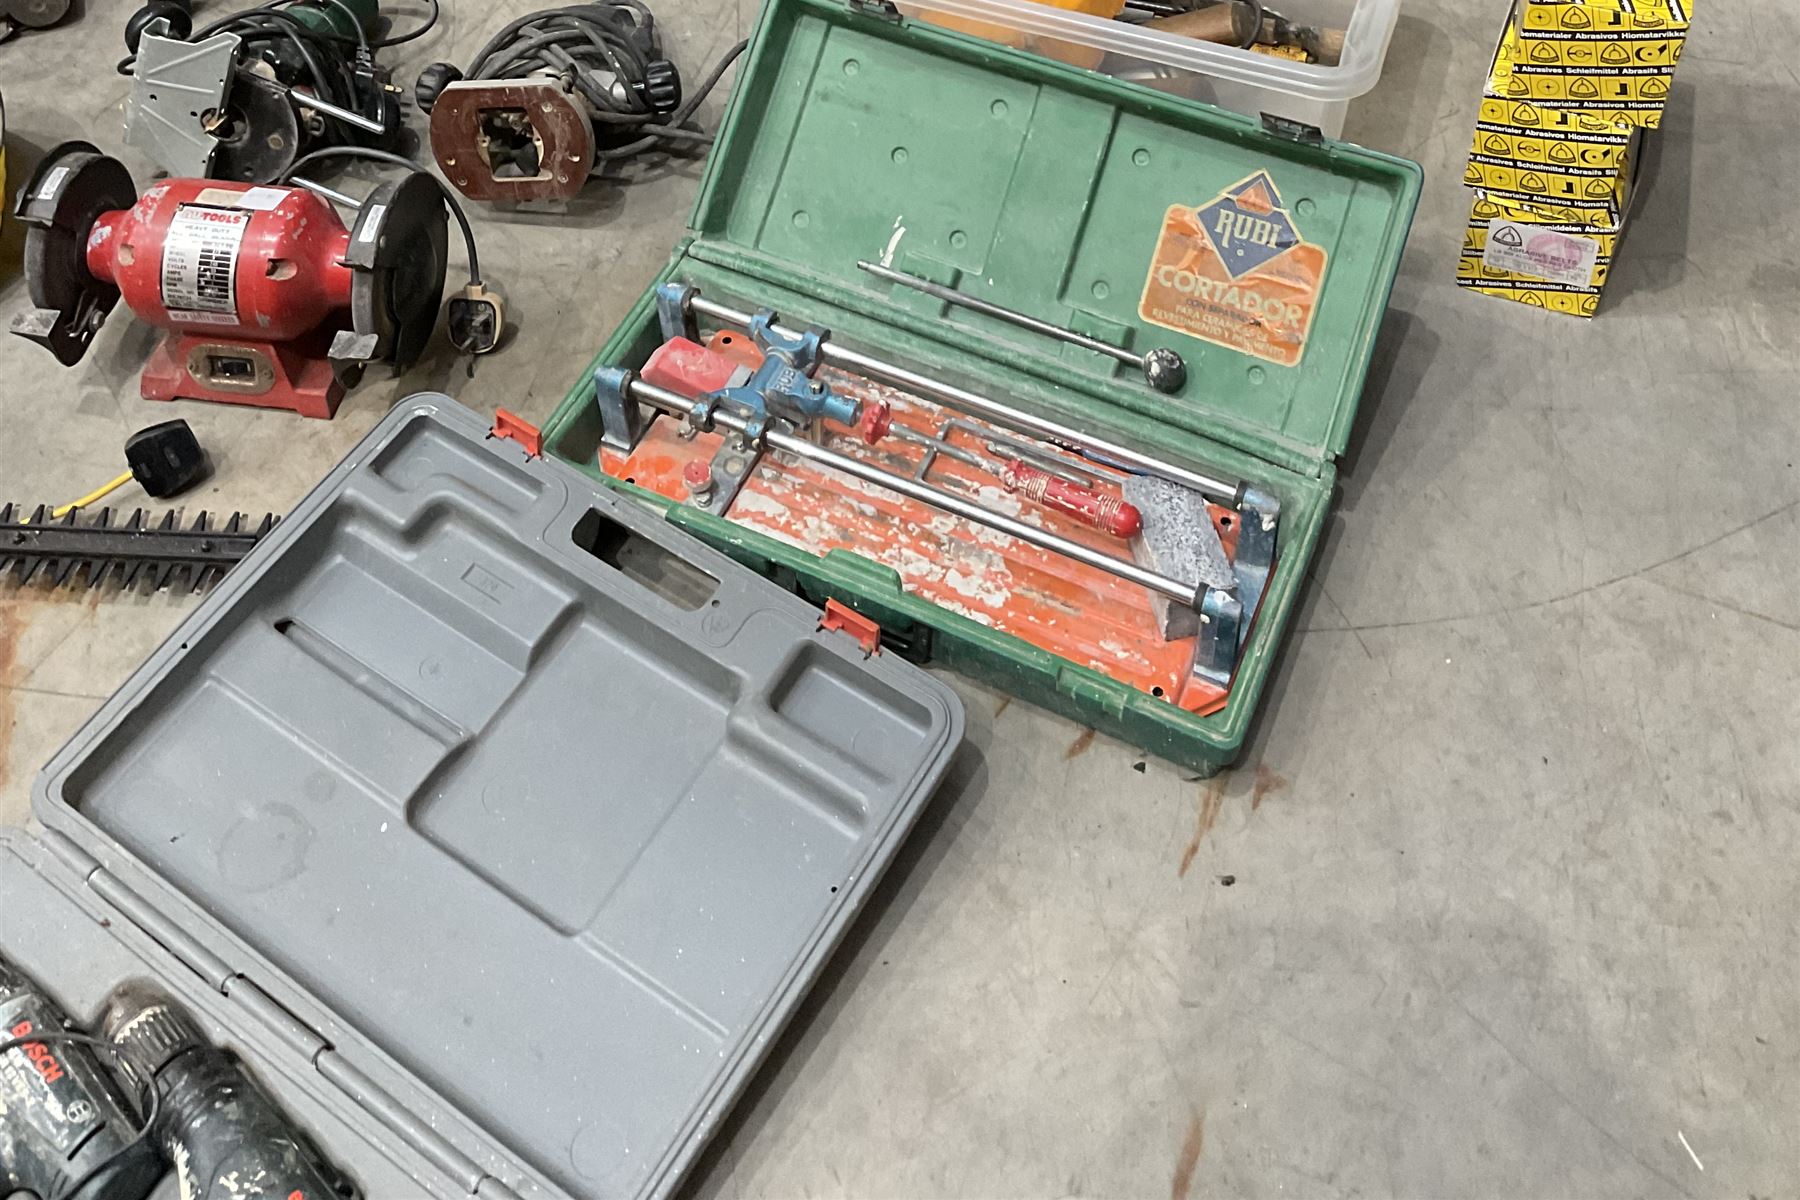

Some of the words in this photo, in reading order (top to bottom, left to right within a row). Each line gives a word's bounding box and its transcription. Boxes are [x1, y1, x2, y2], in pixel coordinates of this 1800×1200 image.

[1575, 32, 1619, 40] Abrasivos
[1521, 65, 1563, 74] Abrasives
[1565, 67, 1619, 75] Schleifmittel
[1621, 66, 1658, 75] Abrasifs
[1583, 101, 1625, 109] Abrasivos
[1525, 128, 1565, 140] Abrasivos
[1476, 155, 1514, 167] Abrasives
[1516, 161, 1566, 173] Schleifmittel
[1568, 167, 1602, 176] Abrasifs
[1532, 195, 1572, 206] Abrasivos
[1214, 208, 1283, 249] RUBI
[1475, 279, 1513, 288] Abrasives
[1515, 282, 1563, 291] Schleifmittel
[1157, 264, 1303, 329] CORTADOR
